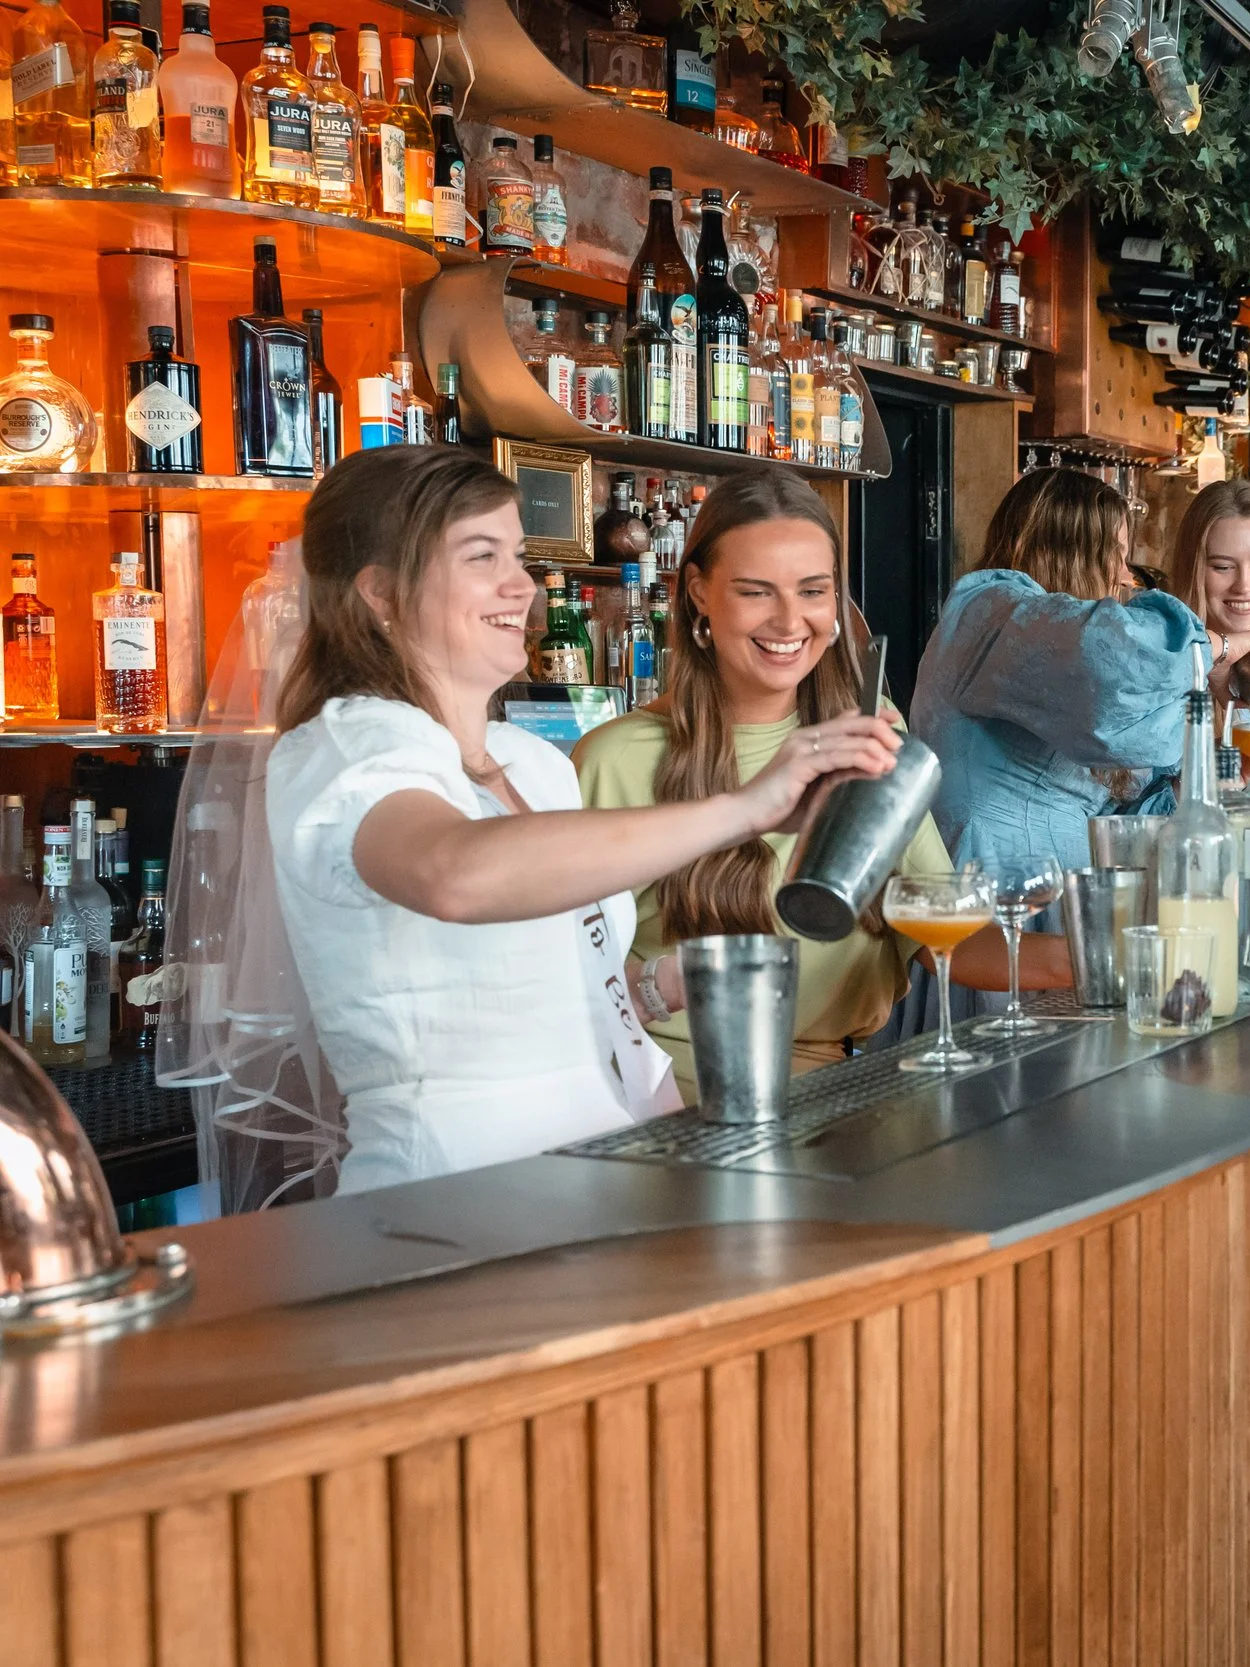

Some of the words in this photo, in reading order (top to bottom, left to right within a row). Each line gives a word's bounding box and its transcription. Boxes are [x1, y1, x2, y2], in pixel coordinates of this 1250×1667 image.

[687, 90, 700, 103] 12
[194, 104, 226, 118] JURA
[270, 106, 310, 122] JURA
[206, 120, 215, 128] 21
[277, 124, 292, 133] SEVEN
[292, 126, 306, 135] WOOD
[269, 379, 306, 392] CROWN
[278, 391, 300, 399] JEWEL
[577, 388, 587, 420] CAMPO
[2, 413, 47, 421] BURROUGH'S
[128, 410, 195, 422] HENDRICK'S
[9, 420, 41, 428] RESERVE
[107, 621, 150, 630] EMINENTE
